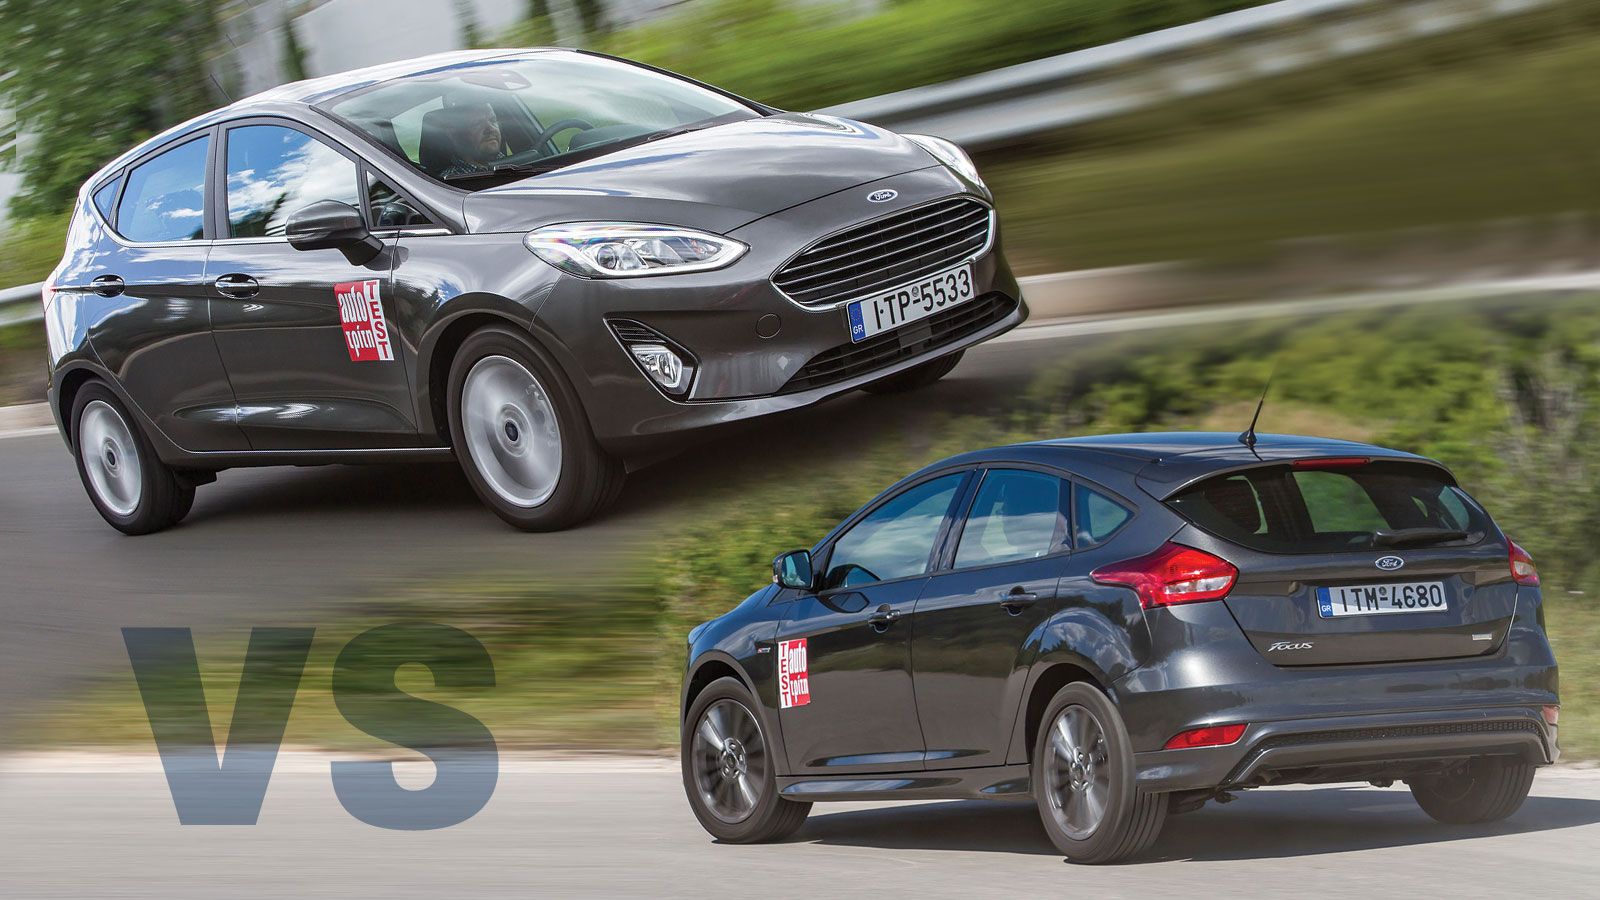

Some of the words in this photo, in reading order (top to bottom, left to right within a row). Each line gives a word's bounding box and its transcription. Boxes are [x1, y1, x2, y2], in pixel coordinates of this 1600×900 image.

[337, 285, 369, 323] auto
[366, 281, 389, 359] TEST
[853, 324, 864, 334] GR
[1321, 605, 1332, 613] GR
[1340, 584, 1443, 612] ITM-4680
[789, 642, 808, 673] auto
[780, 642, 789, 707] TEST
